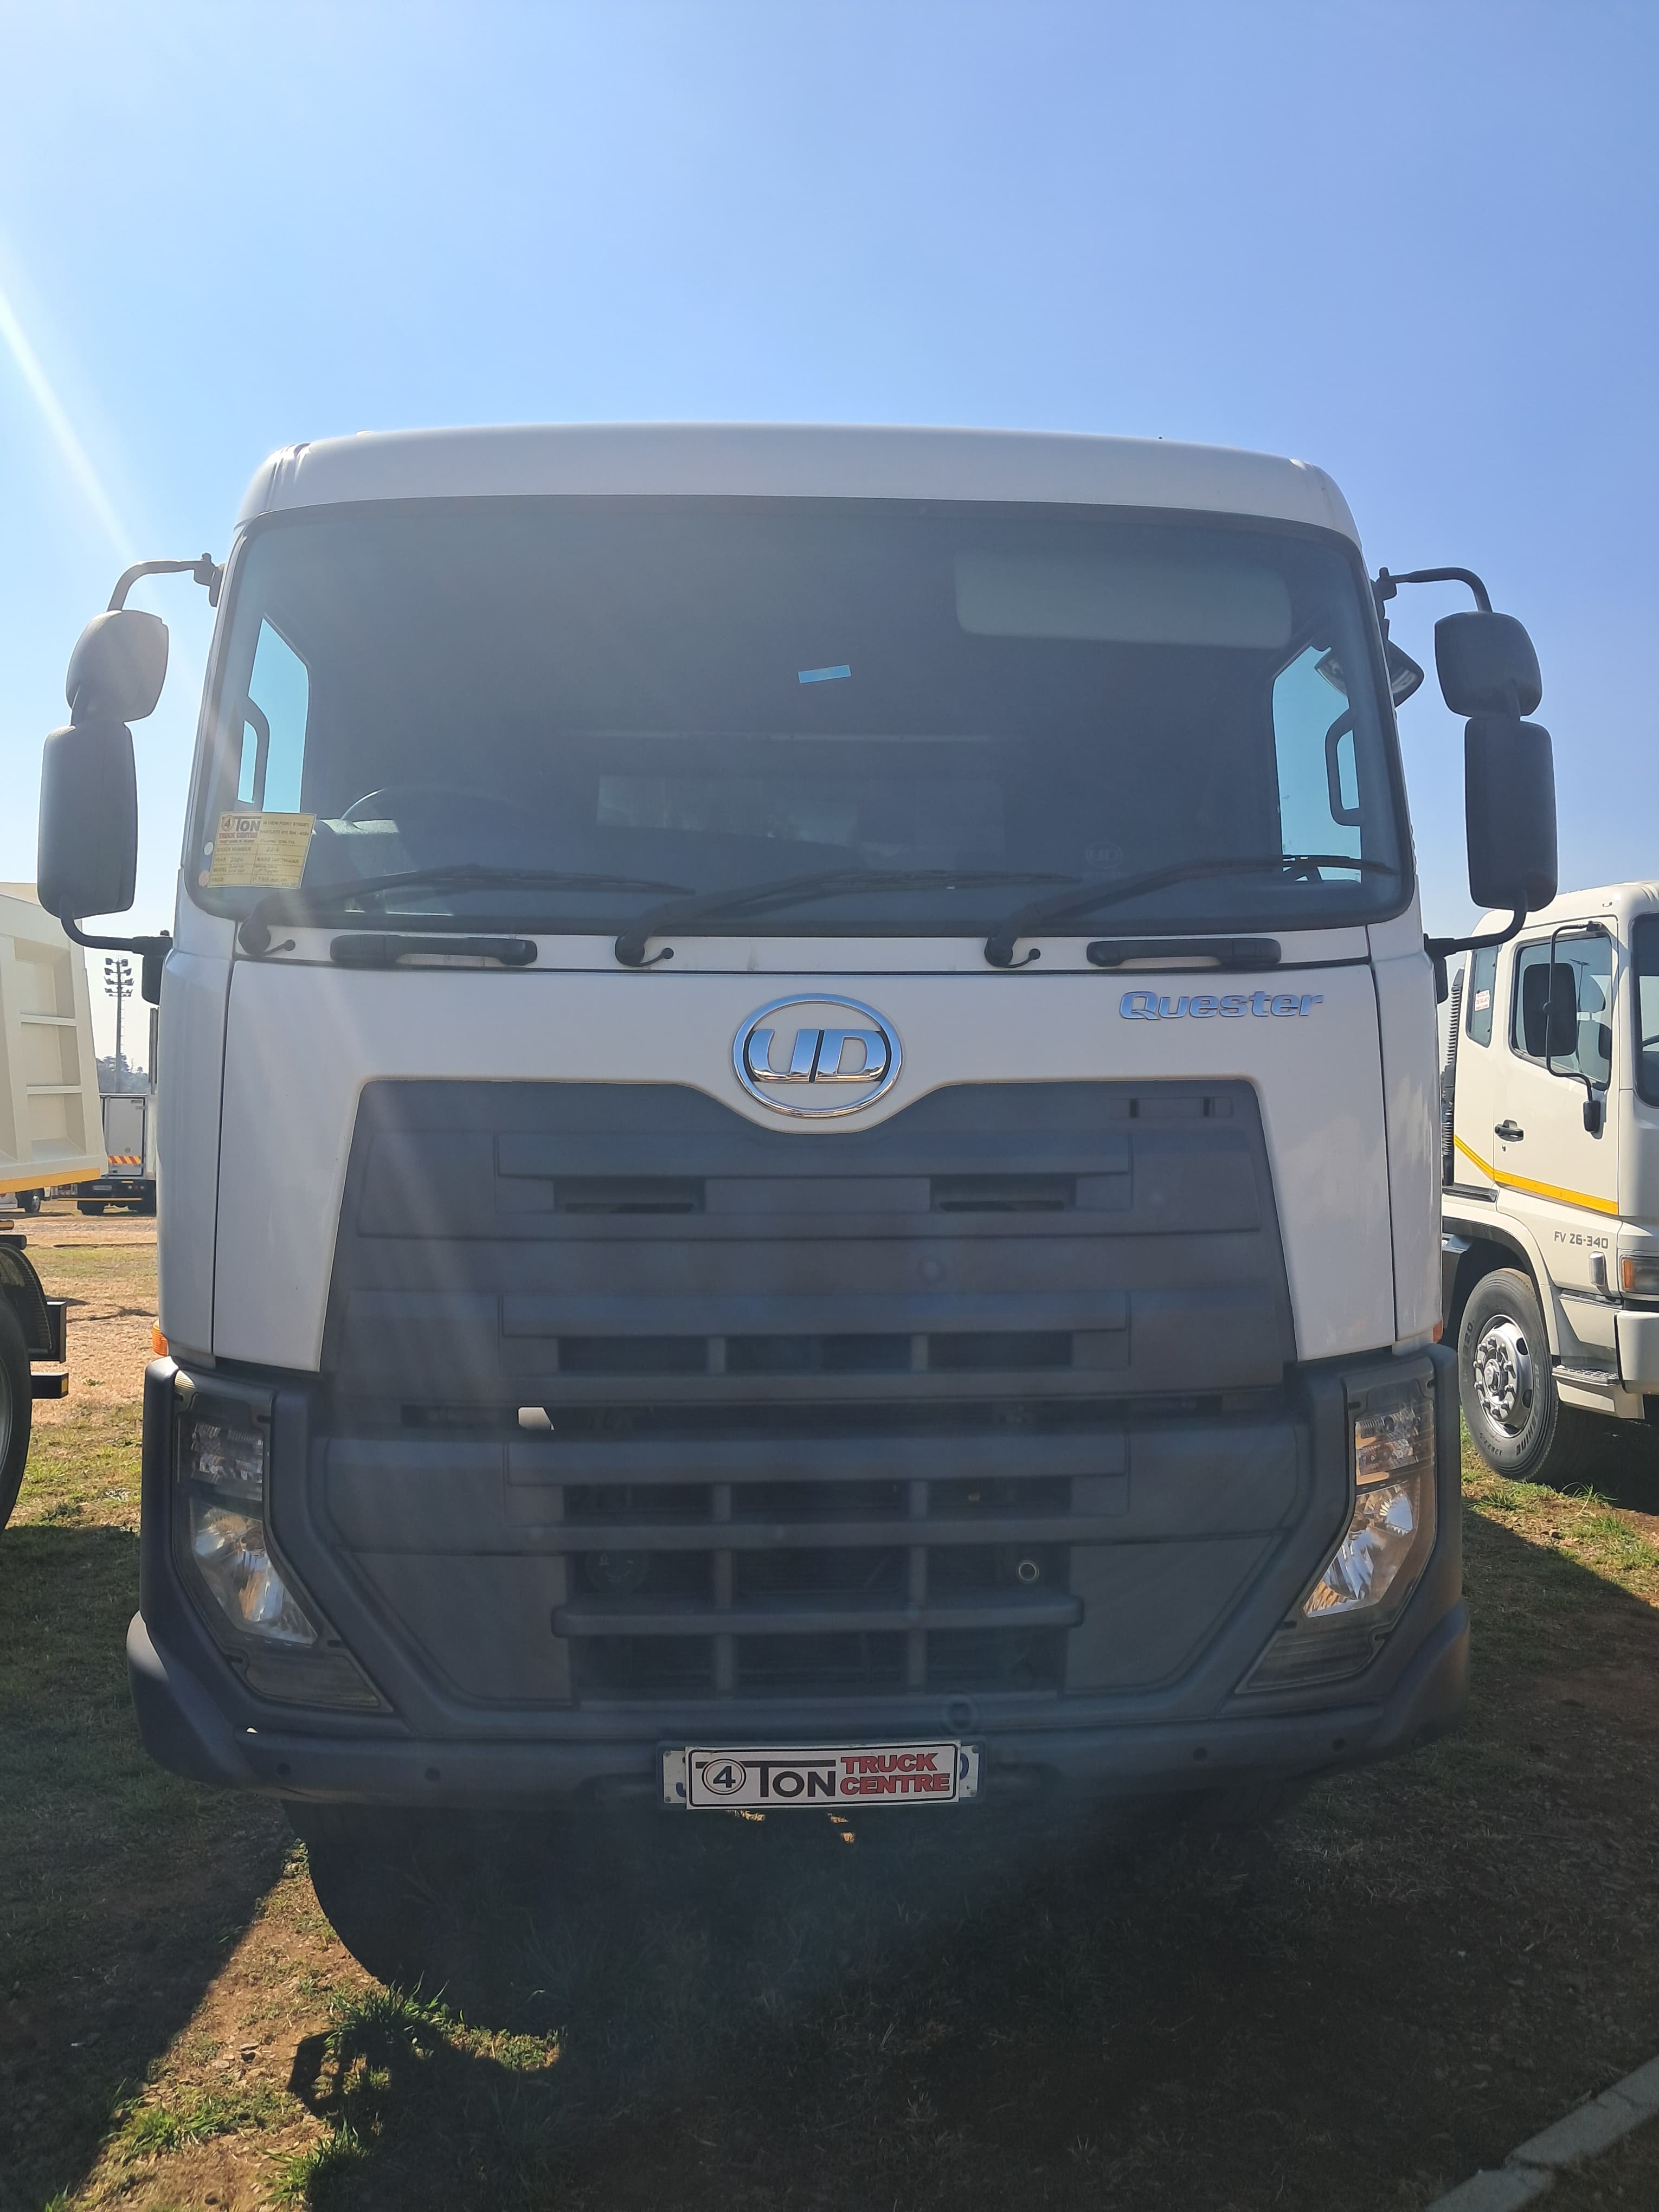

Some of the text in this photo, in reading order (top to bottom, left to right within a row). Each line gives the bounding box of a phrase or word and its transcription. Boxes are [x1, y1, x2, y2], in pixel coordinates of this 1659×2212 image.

[1119, 991, 1323, 1020] Quester
[748, 1029, 887, 1083] UD
[1554, 1231, 1567, 1243] FV
[840, 1752, 939, 1774] TRUCK
[712, 1765, 736, 1788] 4
[743, 1759, 836, 1798] TON
[840, 1773, 950, 1795] CENTRE
